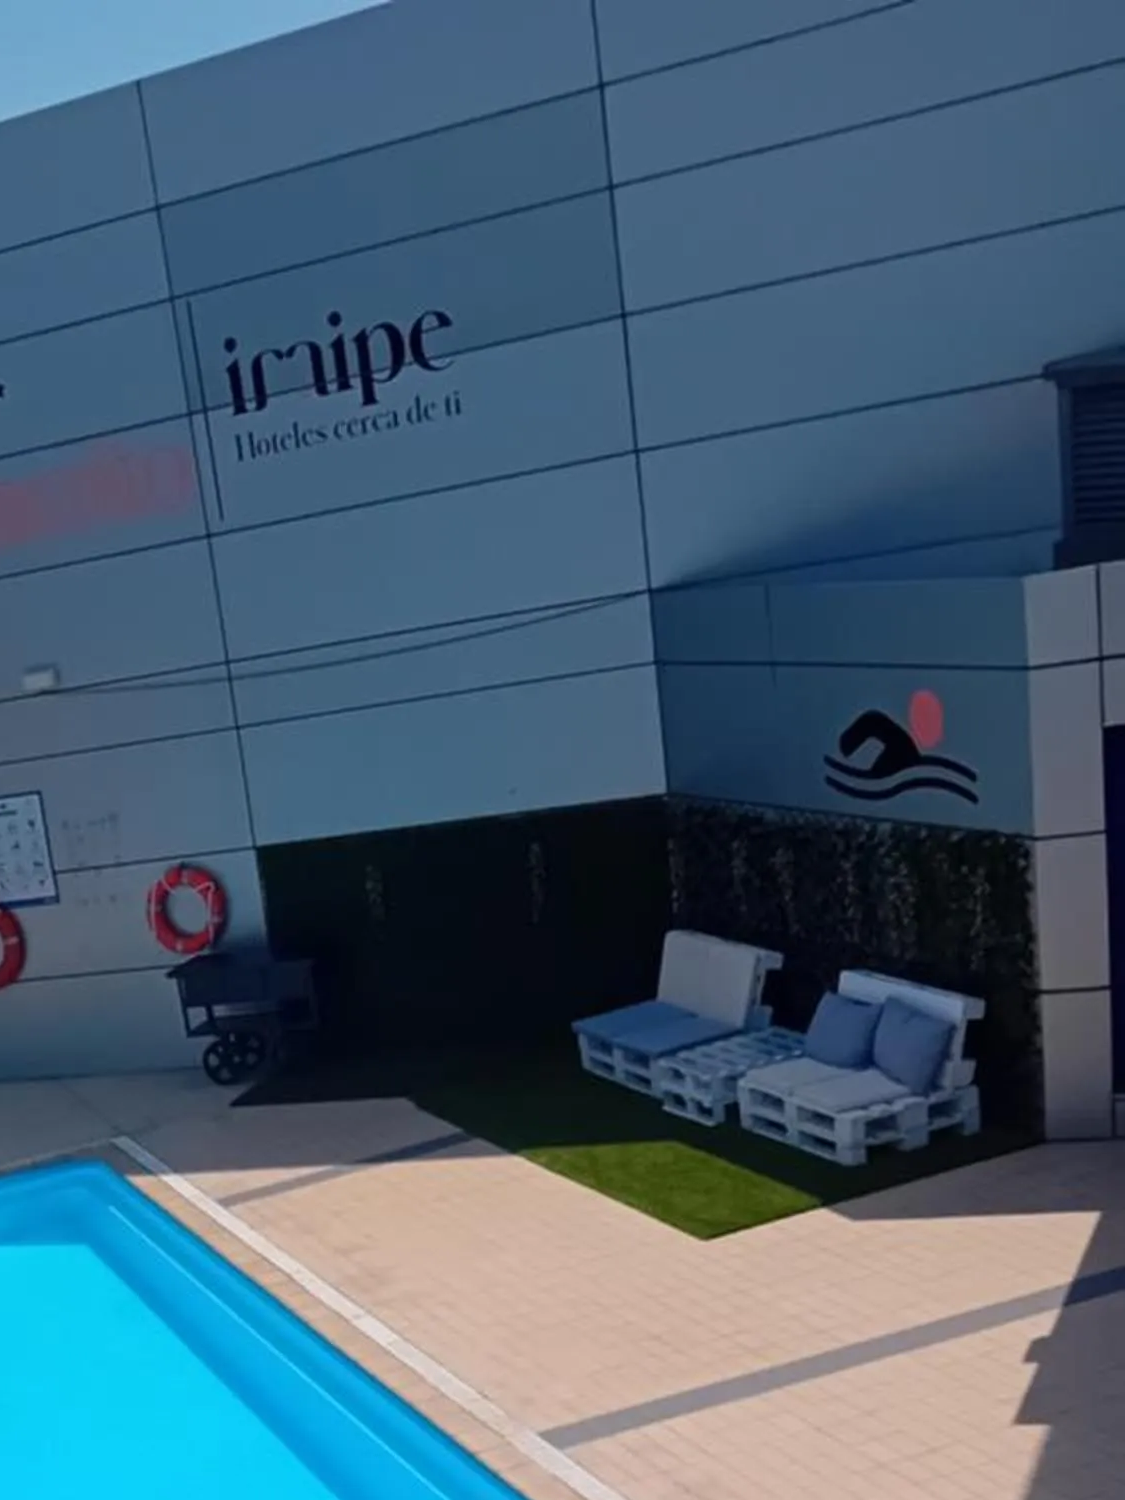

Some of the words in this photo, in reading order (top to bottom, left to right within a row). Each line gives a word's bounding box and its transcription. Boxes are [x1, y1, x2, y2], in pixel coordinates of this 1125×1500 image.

[234, 421, 329, 463] Hoteles
[332, 409, 400, 440] cerca
[406, 395, 435, 424] de
[444, 390, 462, 416] ti
